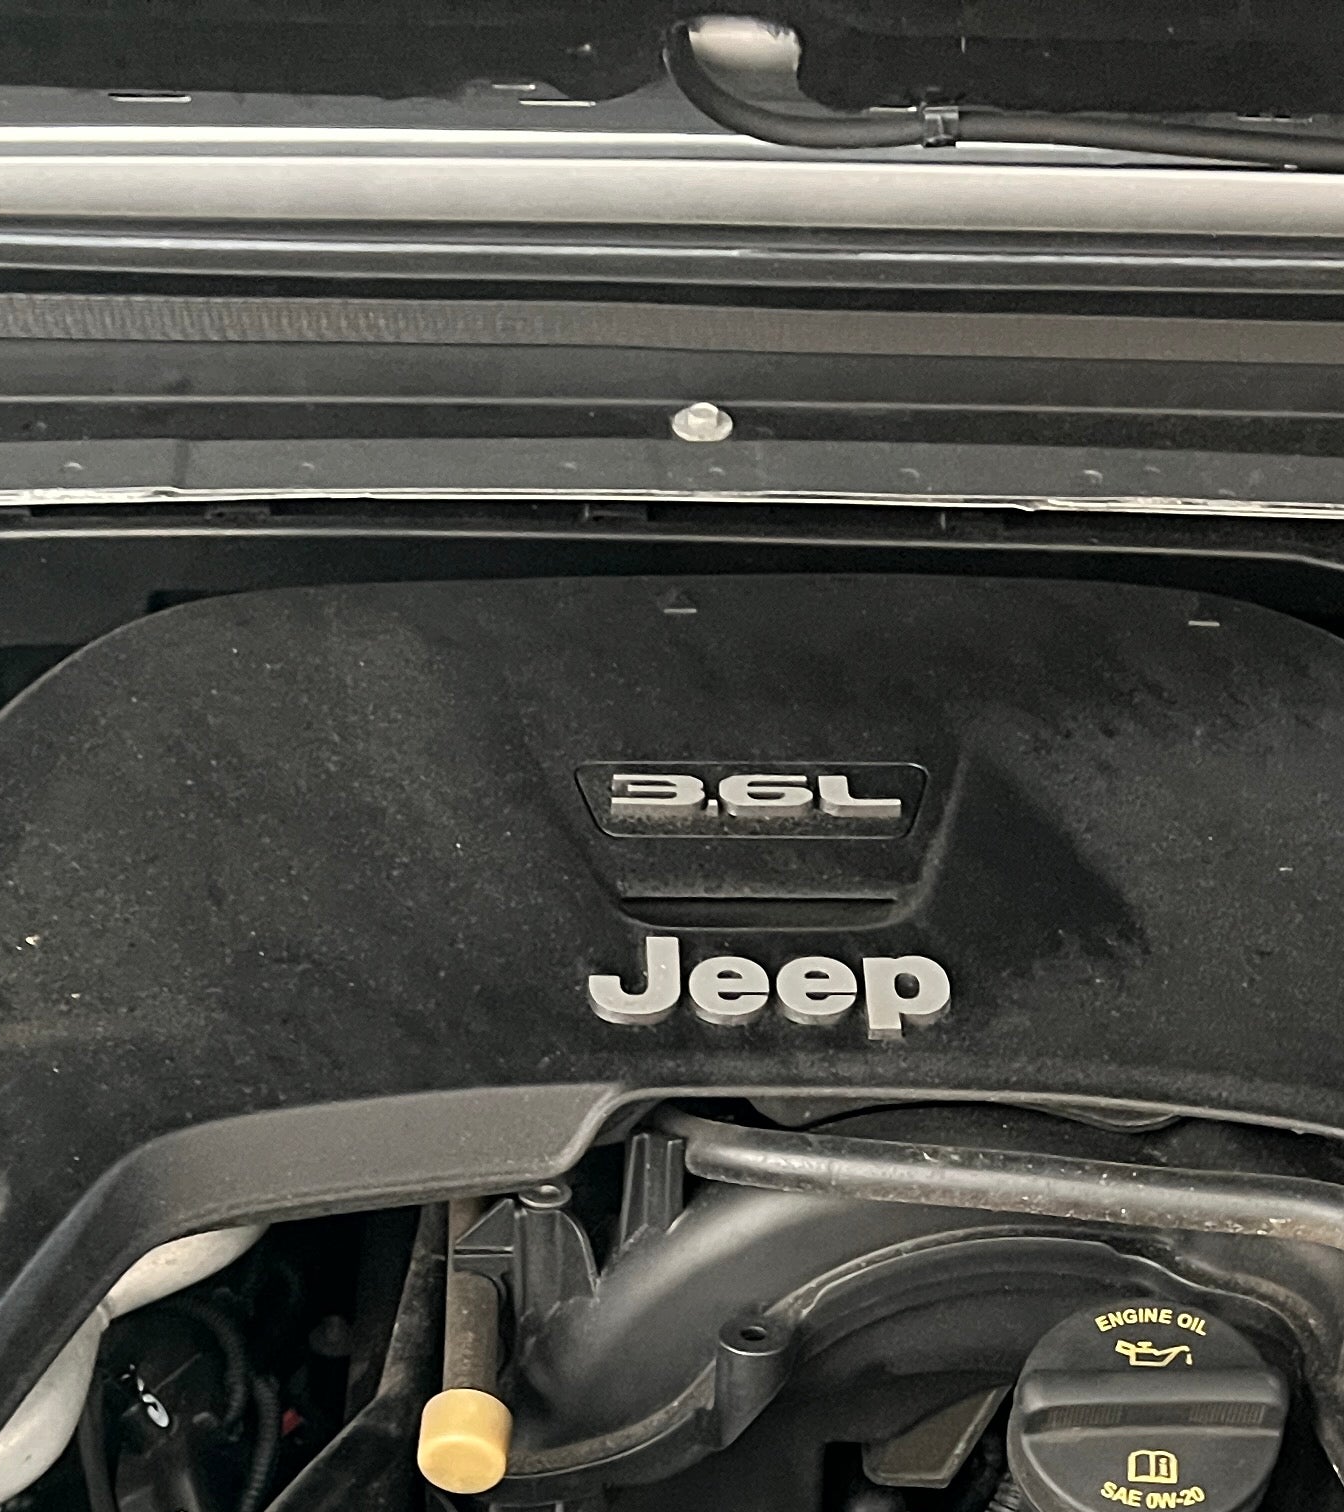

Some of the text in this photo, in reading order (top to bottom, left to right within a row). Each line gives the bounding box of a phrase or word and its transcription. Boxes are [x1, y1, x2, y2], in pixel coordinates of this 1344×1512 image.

[611, 774, 901, 817] 3.6L
[588, 936, 951, 1040] Jeep
[1094, 1308, 1208, 1336] ENGINE OIL
[1101, 1482, 1205, 1509] SAE 0W-20
